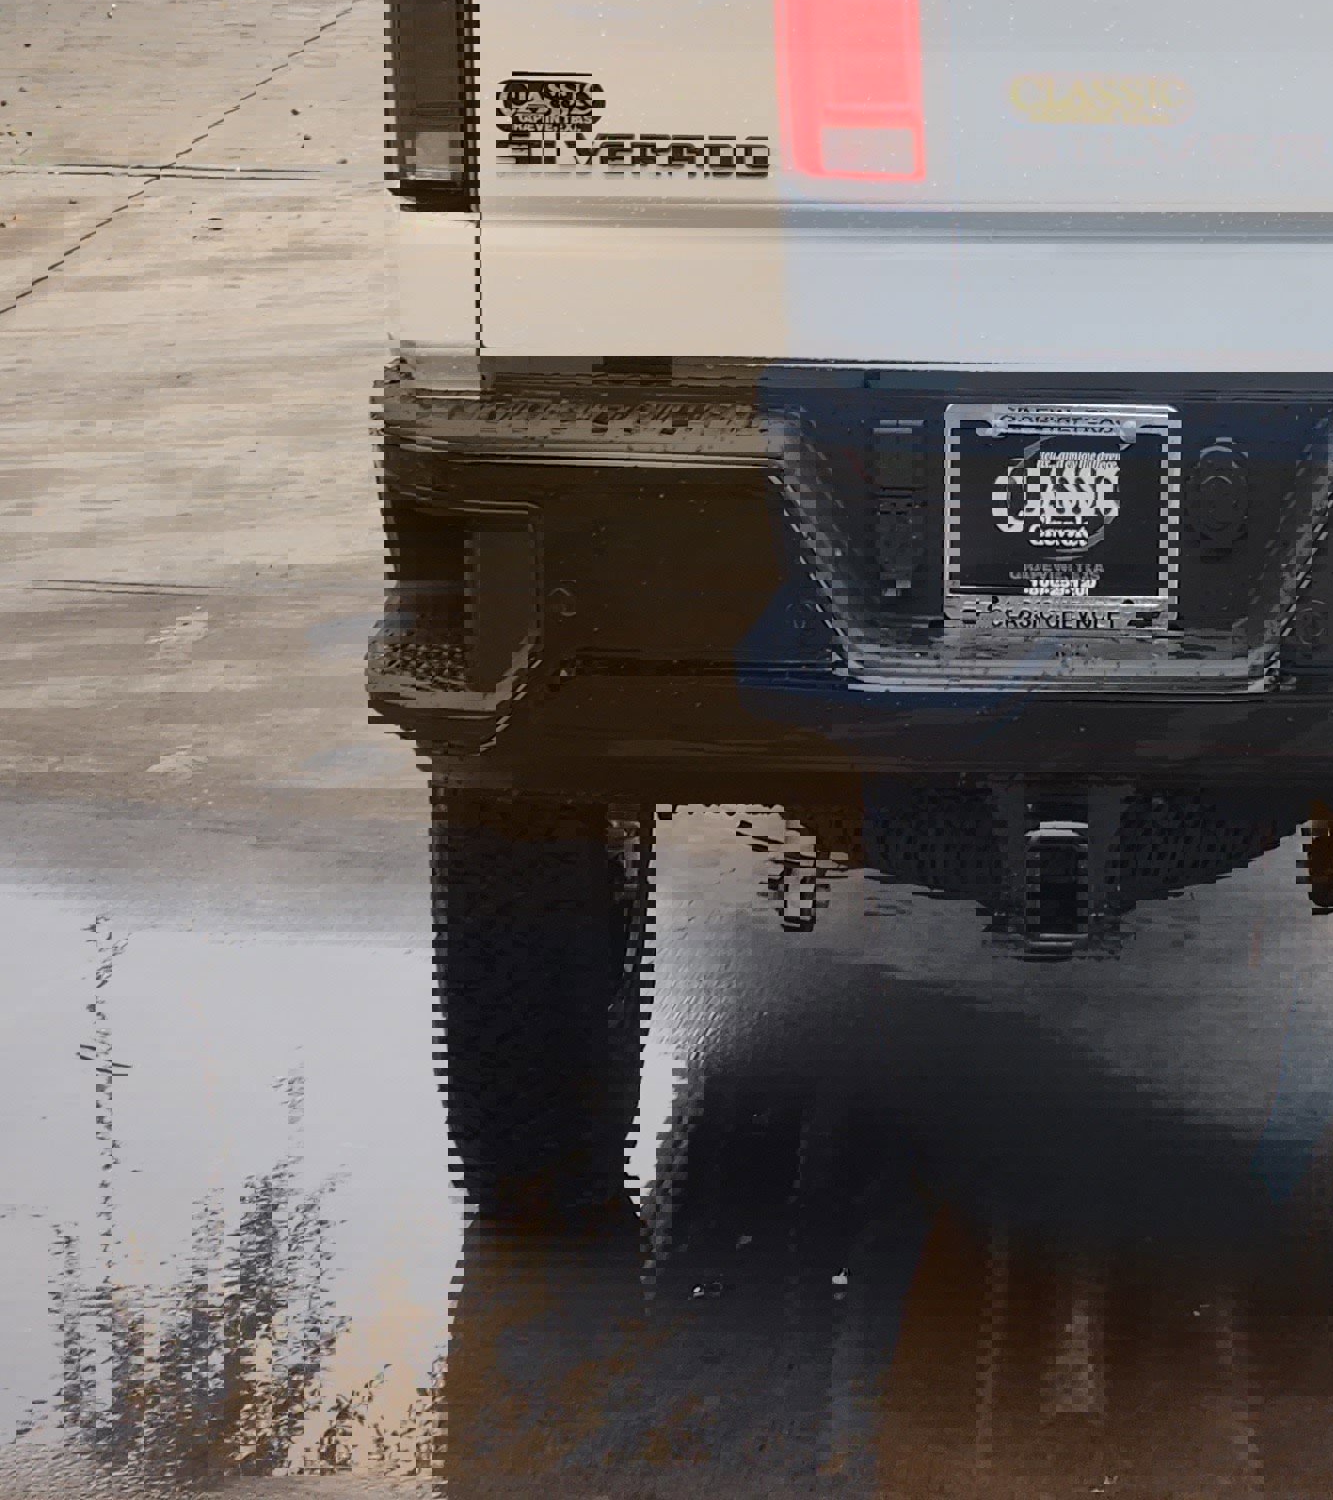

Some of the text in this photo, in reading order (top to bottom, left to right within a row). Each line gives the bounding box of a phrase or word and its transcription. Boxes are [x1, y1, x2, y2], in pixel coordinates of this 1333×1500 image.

[1010, 76, 1186, 113] CLASSIC
[1030, 112, 1173, 125] GRAPEVINE, TEXAS.
